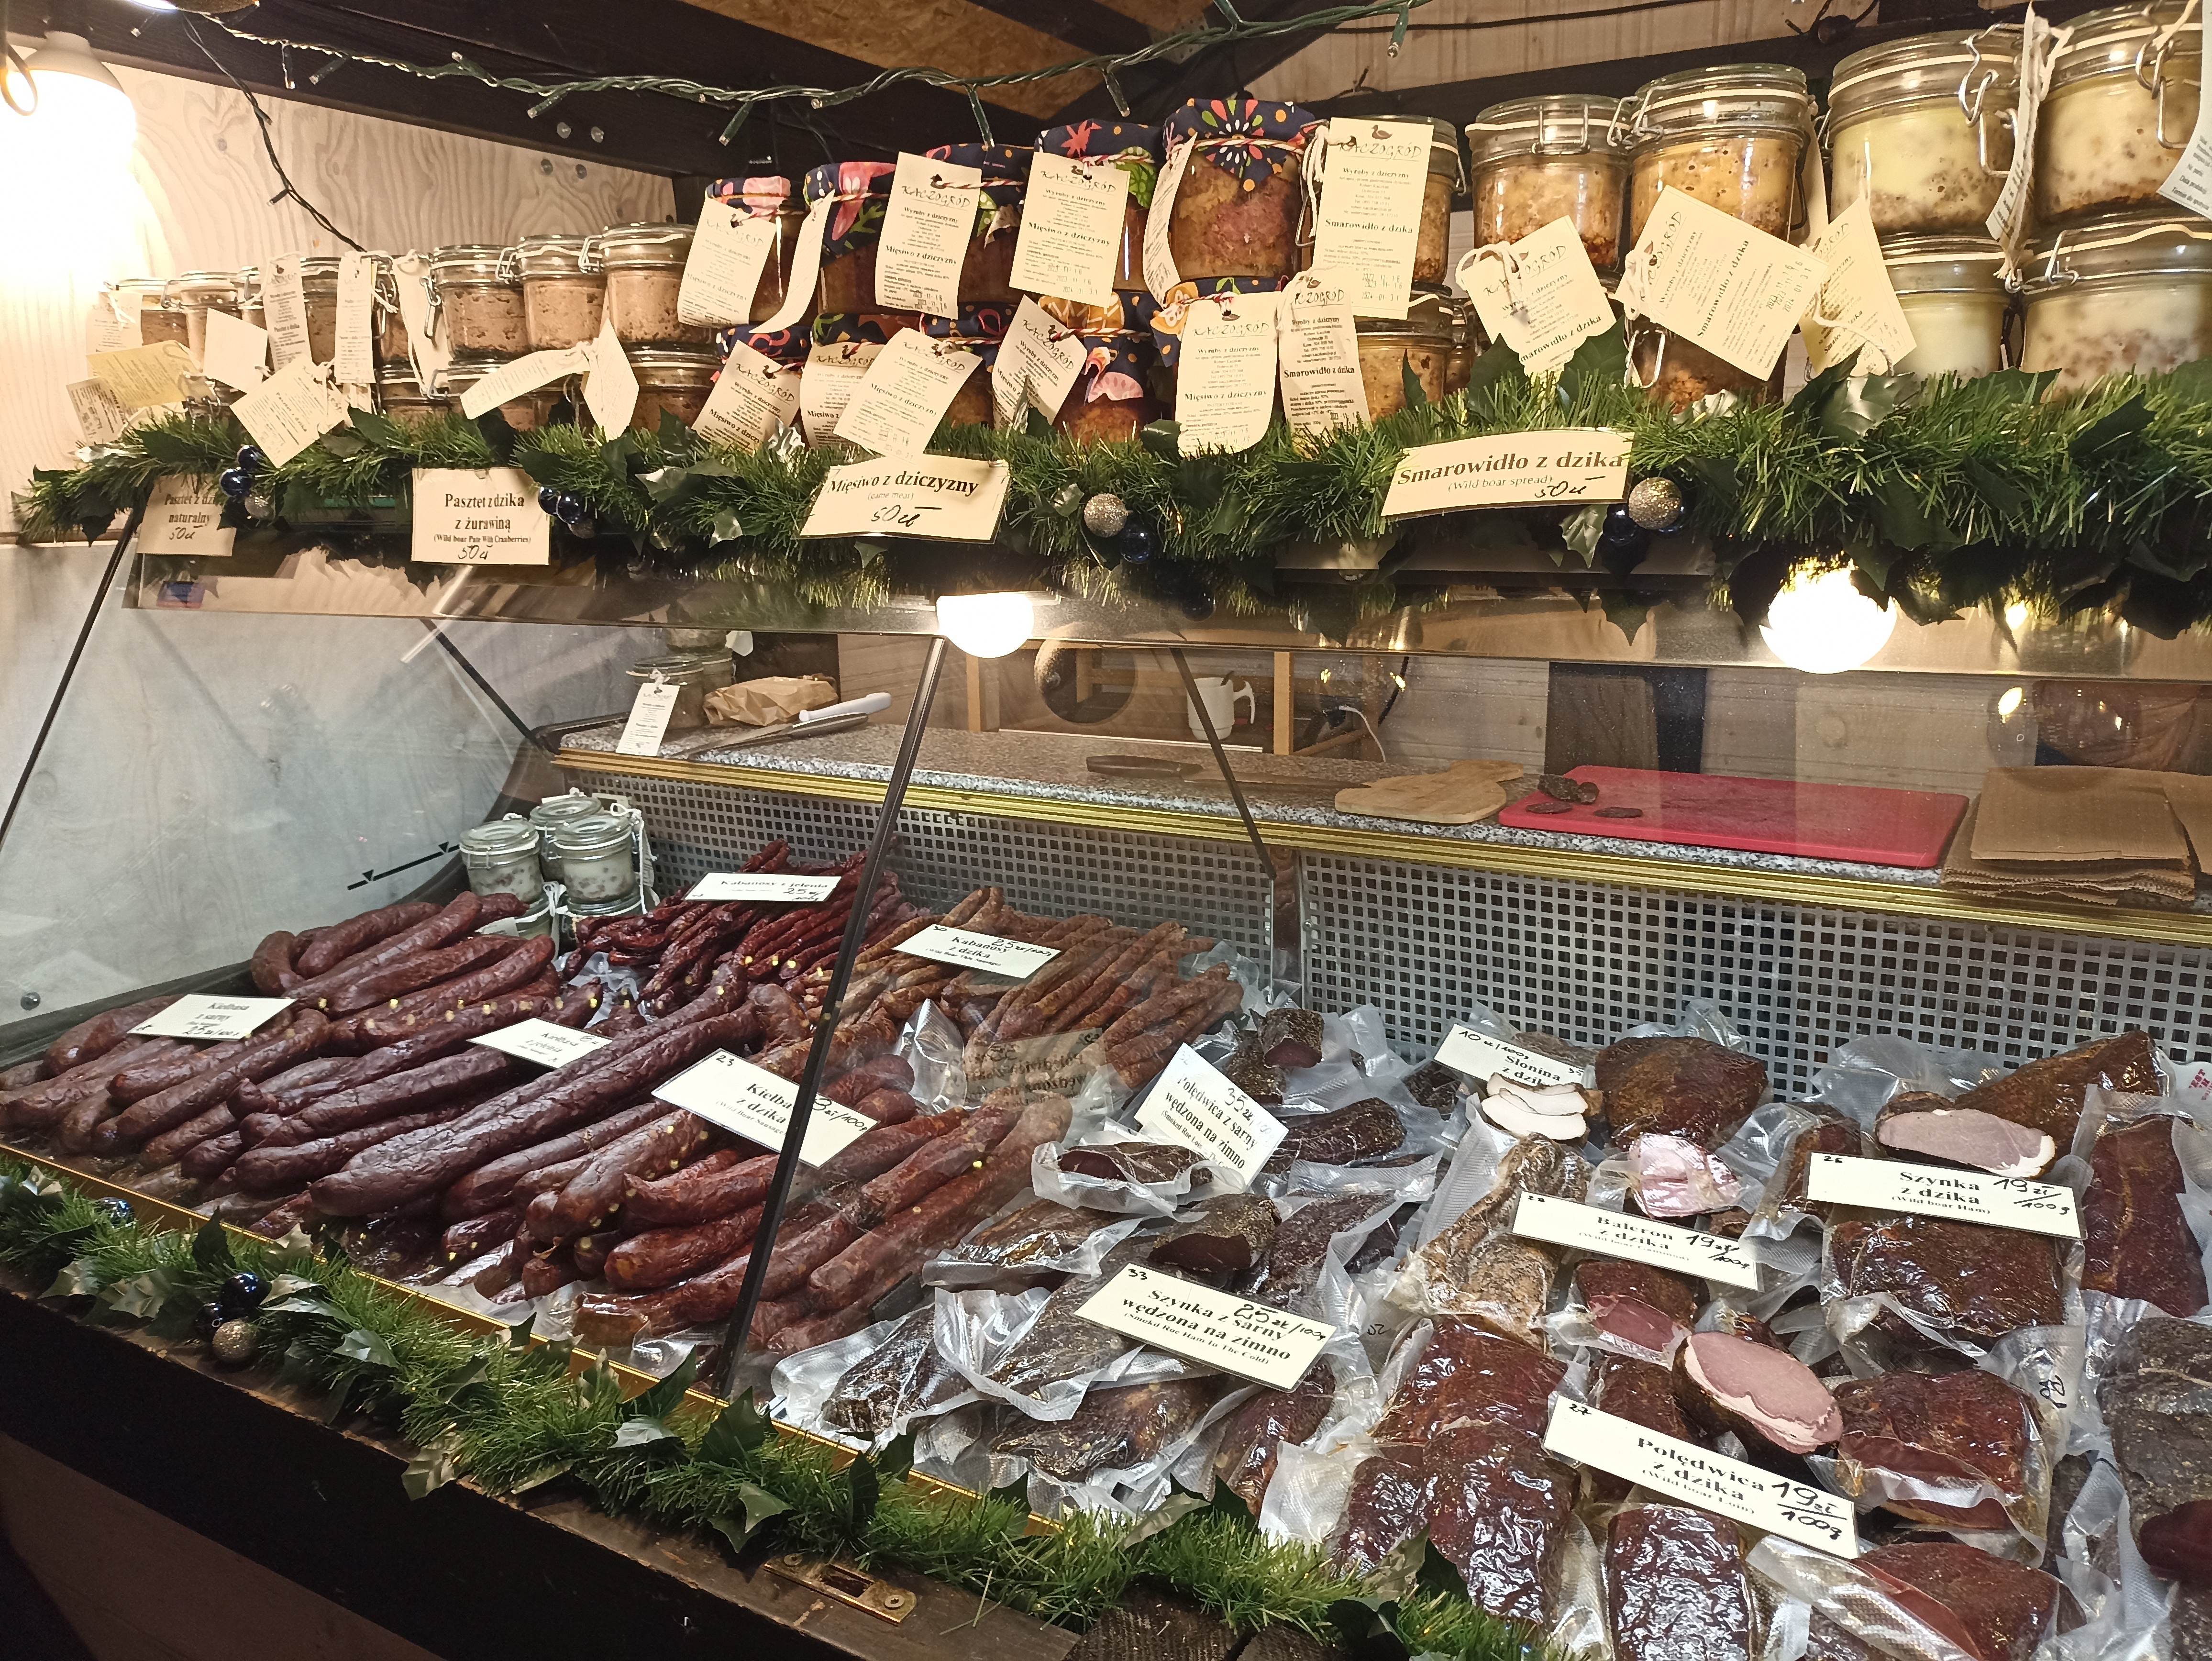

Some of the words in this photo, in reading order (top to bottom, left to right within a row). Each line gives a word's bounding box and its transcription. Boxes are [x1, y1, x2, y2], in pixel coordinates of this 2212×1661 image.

[1028, 222, 1062, 235] Mięsiwo
[1071, 232, 1111, 247] dziczyzny
[1325, 218, 1378, 231] Smarowidło
[1389, 223, 1413, 233] dzika
[1694, 277, 1731, 338] Smarowidło
[1729, 238, 1749, 268] dzika
[1520, 334, 1567, 362] marowidło
[1577, 316, 1601, 332] dzika
[1284, 367, 1331, 378] Smarowidło
[1338, 366, 1355, 376] dzika
[1184, 392, 1218, 401] Mięsiwo
[1227, 390, 1267, 400] dziczyzny
[709, 409, 736, 429] Mięsiwo
[1398, 453, 1528, 484] Smarowidło
[1536, 457, 1547, 468] z
[1557, 452, 1622, 467] dzika
[827, 476, 879, 493] Mięsiwo
[883, 476, 890, 485] z
[896, 471, 979, 497] dziczyzny
[1448, 480, 1479, 492] (Wild
[1483, 477, 1506, 487] boar
[1510, 475, 1552, 486] spread)
[165, 494, 192, 505] Pasztet
[445, 494, 486, 508] Pasztet
[488, 498, 492, 508] z
[494, 493, 524, 507] dzika
[868, 492, 889, 500] (game
[892, 492, 913, 500] meat)
[169, 512, 210, 526] naturalny
[455, 520, 461, 529] z
[465, 517, 510, 532] żurawiną
[951, 937, 1009, 953] Kabanosy
[958, 947, 991, 958] dzika
[716, 1055, 733, 1066] 23
[1505, 1055, 1561, 1082] Słonina
[737, 1110, 755, 1121] Boar
[747, 1102, 786, 1124] dzika
[1165, 1092, 1204, 1131] wędzona
[1203, 1129, 1217, 1143] na
[1218, 1140, 1245, 1169] zimno
[1182, 1127, 1192, 1140] Roe
[1222, 1116, 1231, 1126] z
[1232, 1122, 1259, 1151] sarny
[1900, 1172, 1980, 1191] Szynka
[1891, 1196, 1924, 1205] (Wild
[1927, 1200, 1954, 1208] boar
[1958, 1205, 1991, 1215] Ham)
[1919, 1188, 1980, 1205] dzika
[1598, 1216, 1673, 1240] Baleron
[1615, 1231, 1670, 1250] dzika
[1128, 1268, 1148, 1280] 33
[1148, 1290, 1213, 1318] Szynka
[1217, 1314, 1228, 1322] z
[1232, 1318, 1288, 1341] sarny
[1123, 1298, 1198, 1330] wędzona
[1204, 1327, 1227, 1340] na
[1232, 1334, 1291, 1360] zimno
[1163, 1325, 1181, 1336] Roe
[1183, 1330, 1206, 1344] Ham
[1208, 1339, 1218, 1347] In
[1222, 1343, 1239, 1354] The
[1242, 1350, 1269, 1366] Cold)
[1637, 1437, 1765, 1491] Polędwica
[1653, 1462, 1665, 1472] z
[1674, 1469, 1744, 1501] dzika
[1642, 1469, 1678, 1488] (Wild
[1684, 1482, 1714, 1498] boar
[1718, 1496, 1754, 1515] Loin)
